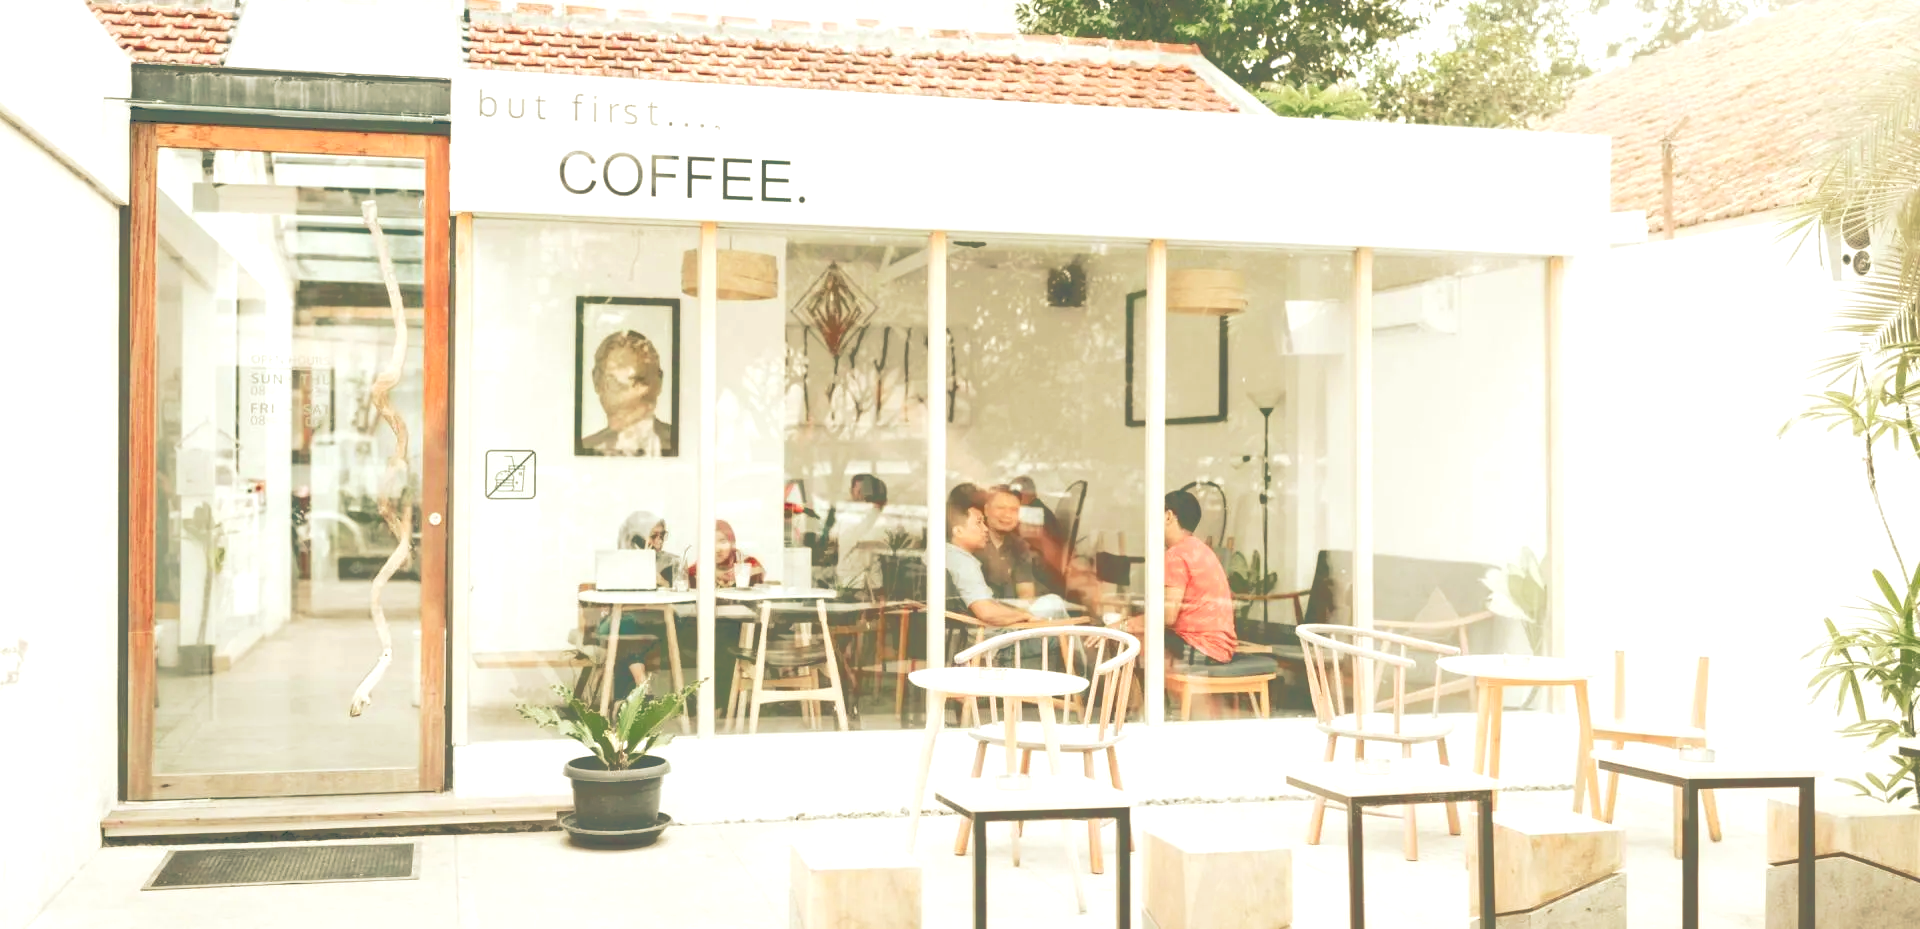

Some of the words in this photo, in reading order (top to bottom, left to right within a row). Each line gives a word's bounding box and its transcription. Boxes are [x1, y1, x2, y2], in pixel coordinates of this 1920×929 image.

[479, 89, 546, 120] but
[559, 150, 806, 203] COFFEE.
[251, 372, 283, 385] SUN
[250, 402, 275, 414] FRI
